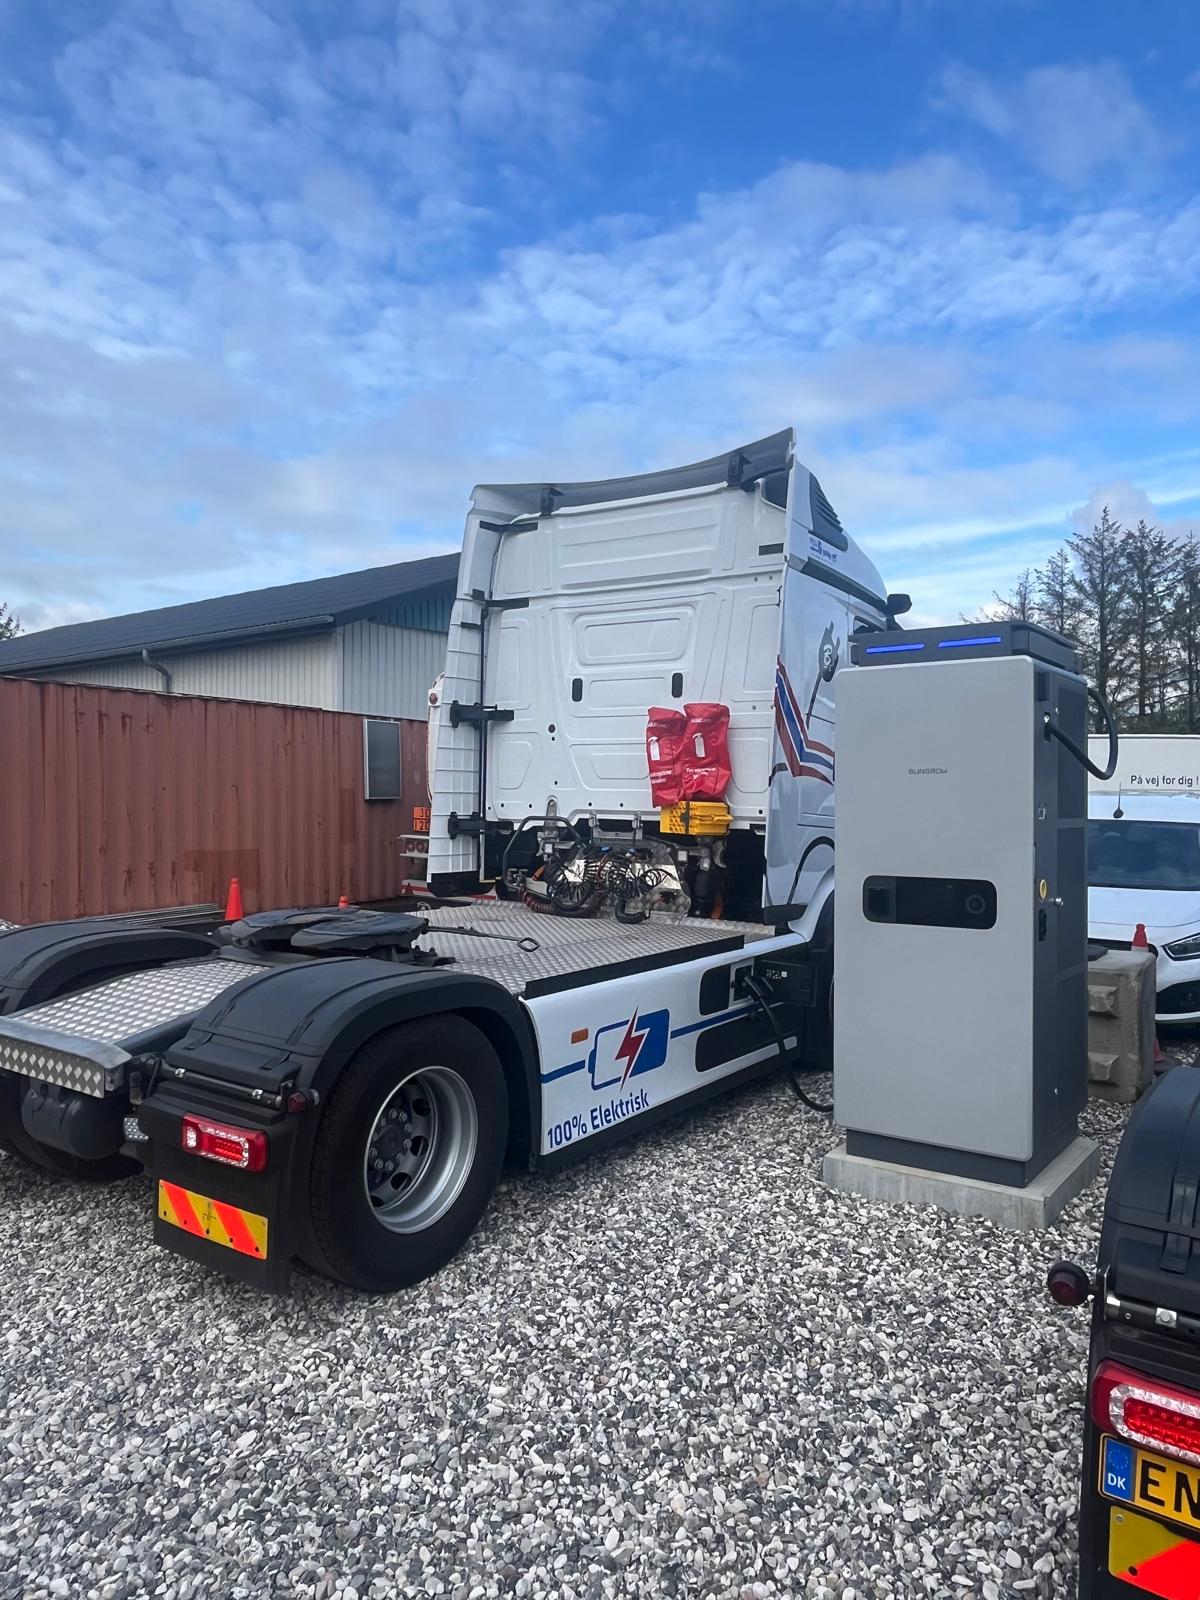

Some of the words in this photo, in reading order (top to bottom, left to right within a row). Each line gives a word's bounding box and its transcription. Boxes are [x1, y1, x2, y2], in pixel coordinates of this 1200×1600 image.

[1130, 774, 1143, 785] På
[1145, 775, 1160, 787] vej
[1162, 775, 1176, 785] for
[1177, 775, 1193, 788] dig
[547, 1113, 588, 1149] 100%
[590, 1088, 650, 1131] Elektrisk
[1107, 1472, 1126, 1491] DK
[1139, 1458, 1200, 1521] EN
